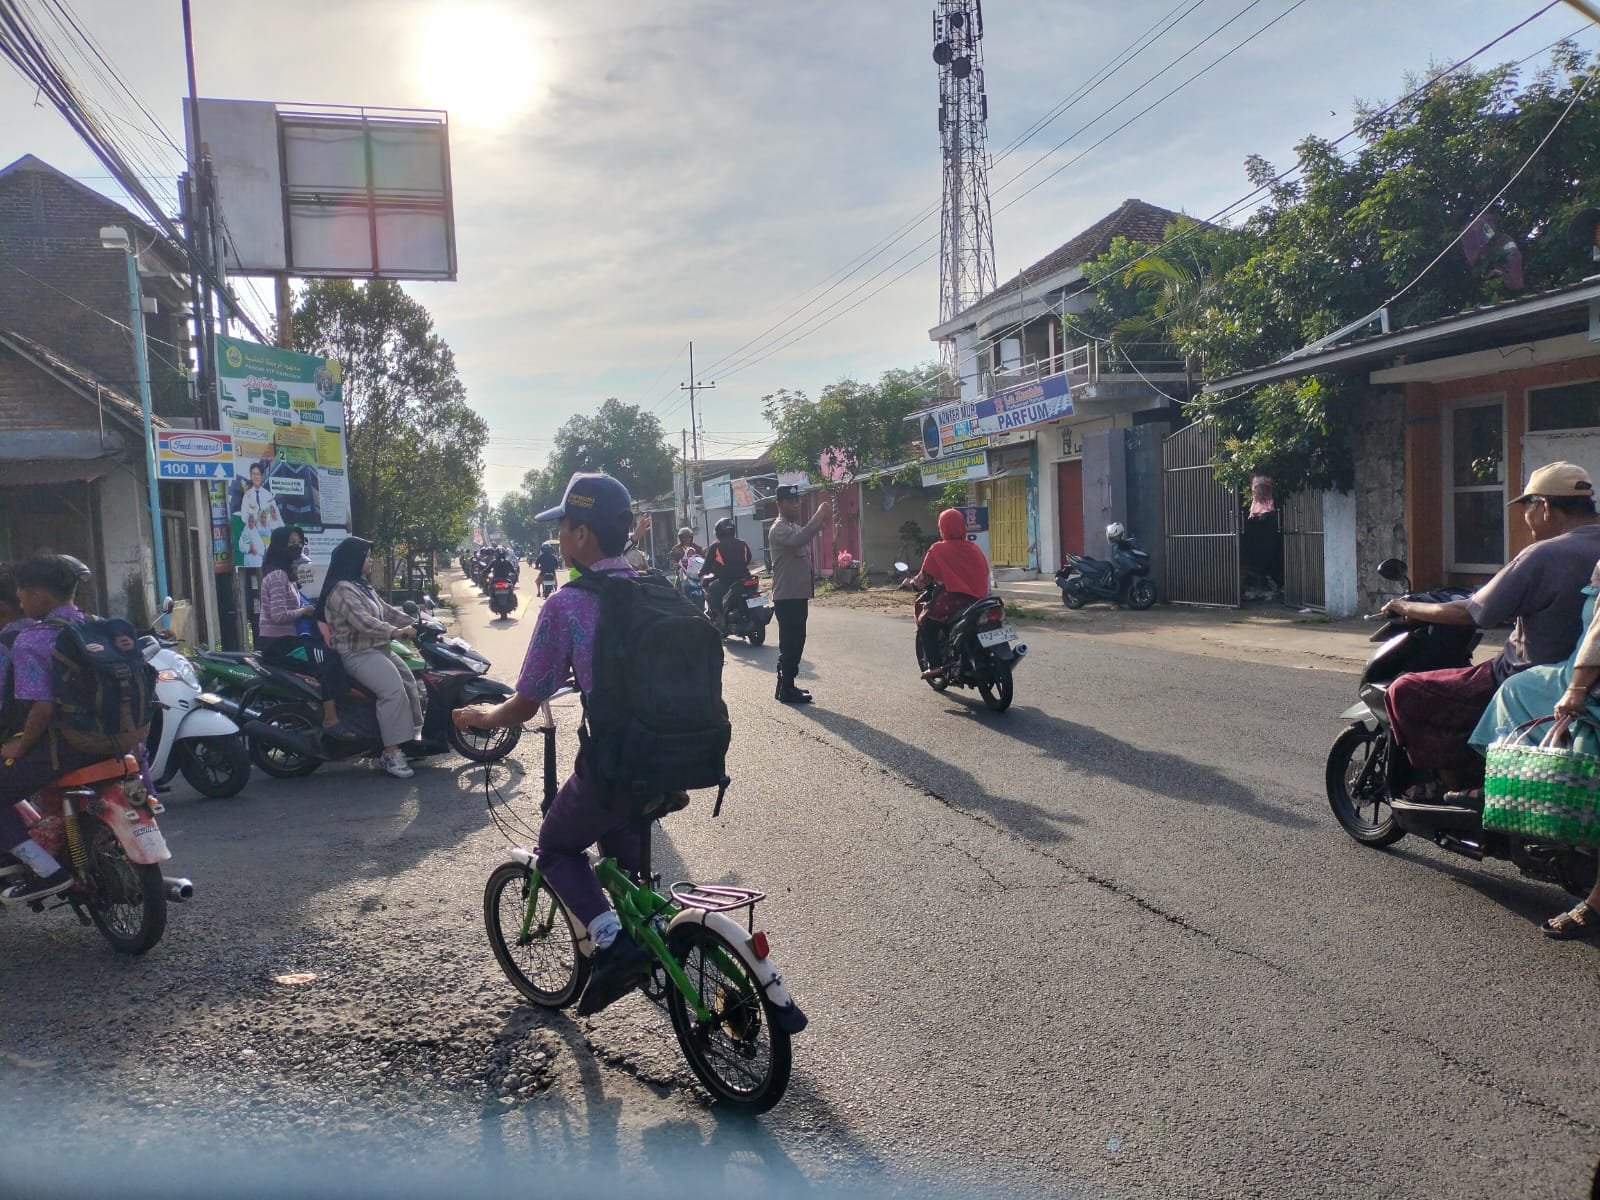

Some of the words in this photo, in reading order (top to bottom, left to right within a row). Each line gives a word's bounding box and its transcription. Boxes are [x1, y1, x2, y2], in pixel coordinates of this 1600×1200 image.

[248, 387, 290, 409] PSB
[997, 403, 1049, 429] PARFUM
[173, 441, 219, 452] Indomaret
[164, 463, 189, 475] 100
[194, 464, 206, 475] M
